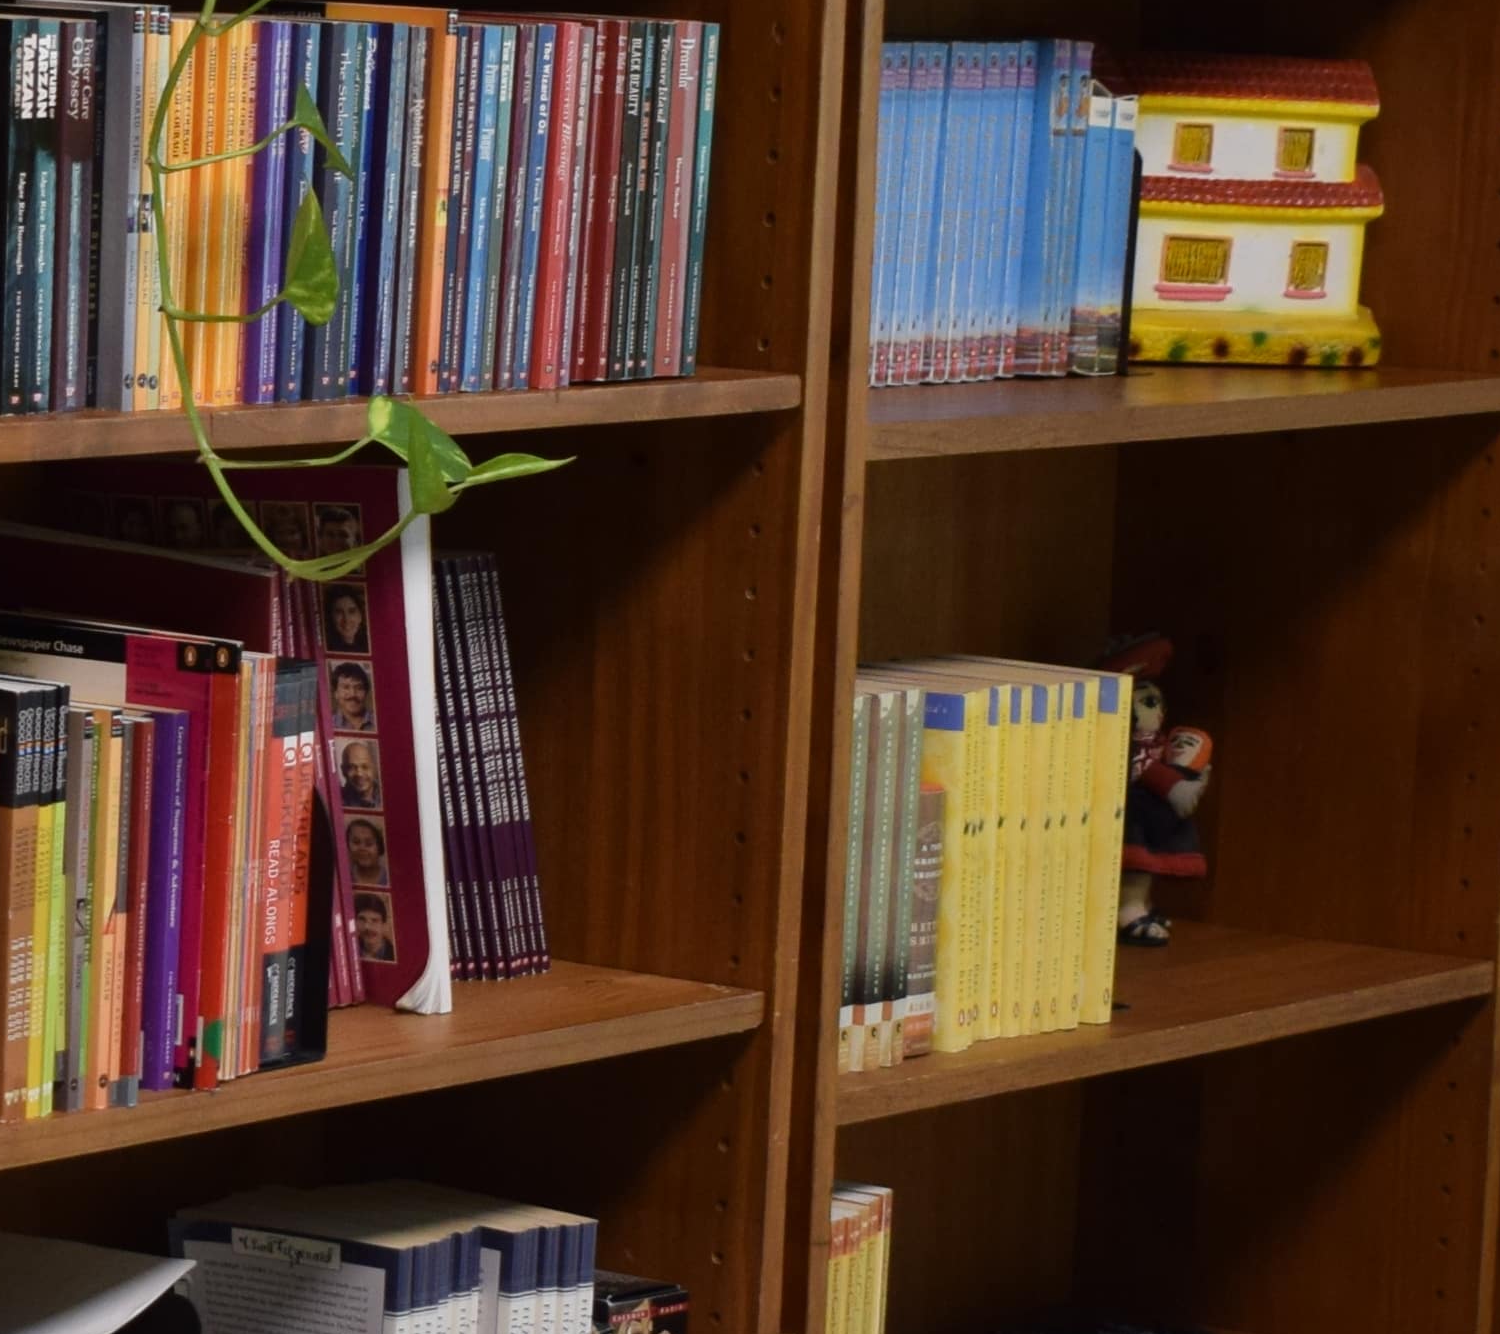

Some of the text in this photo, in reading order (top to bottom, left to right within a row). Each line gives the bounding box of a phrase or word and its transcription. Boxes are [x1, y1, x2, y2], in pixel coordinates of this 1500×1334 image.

[21, 34, 37, 119] TARZAN
[36, 34, 51, 119] TARZAN
[68, 37, 85, 120] Odyssey
[81, 38, 94, 119] Foster Care
[53, 640, 84, 654] Chase
[264, 839, 281, 946] READ-ALONGS
